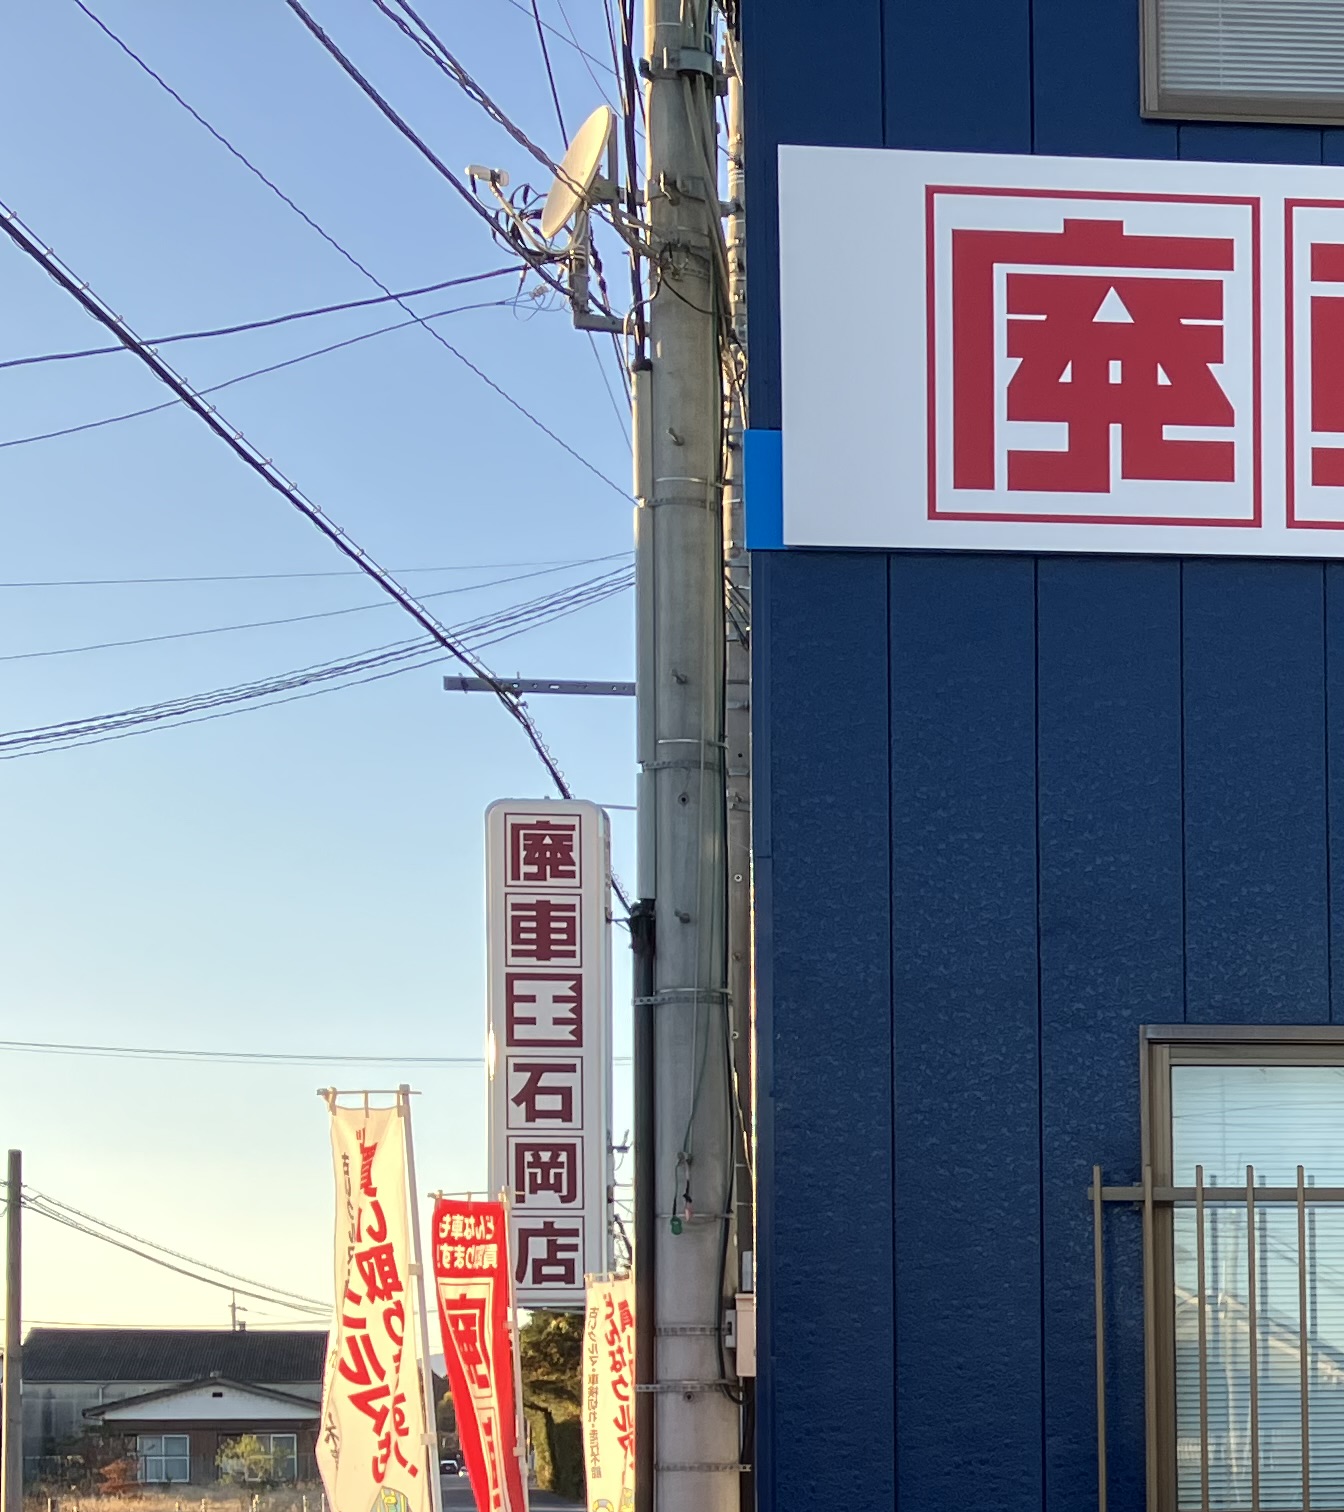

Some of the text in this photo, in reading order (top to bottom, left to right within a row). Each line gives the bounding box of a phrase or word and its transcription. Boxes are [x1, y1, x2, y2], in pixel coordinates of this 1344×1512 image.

[508, 819, 582, 1286] 廃車王石岡店
